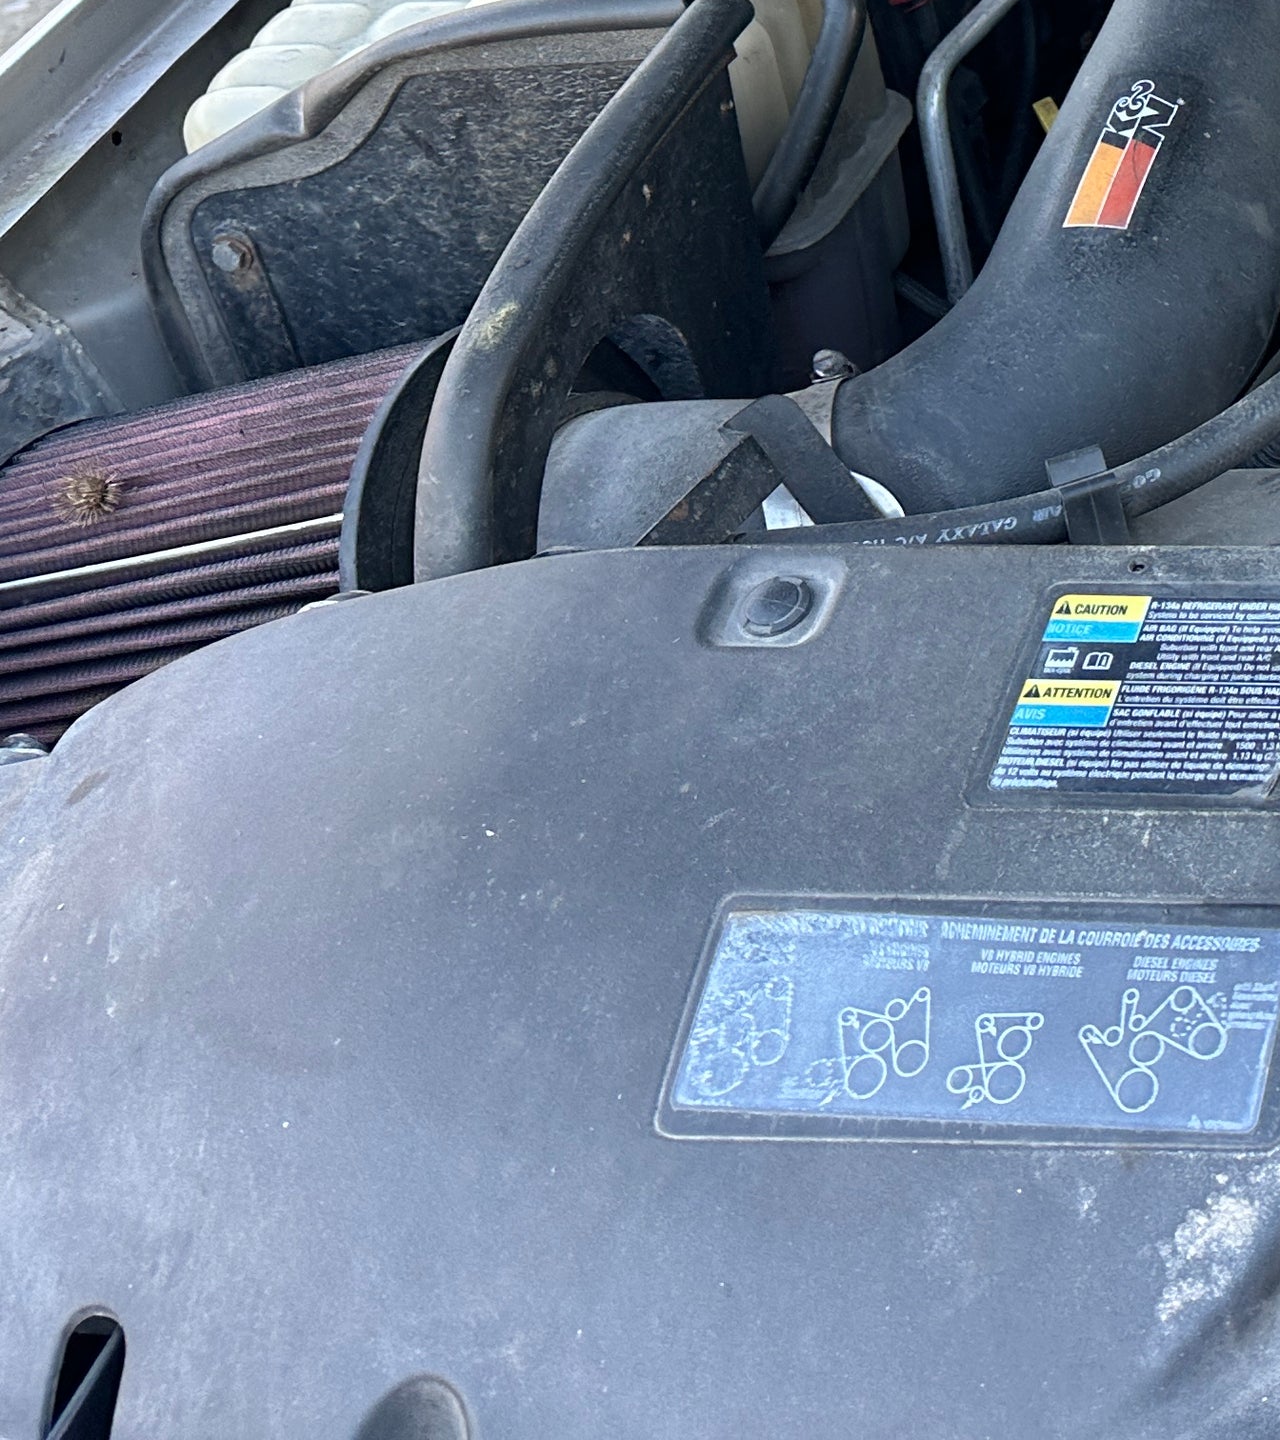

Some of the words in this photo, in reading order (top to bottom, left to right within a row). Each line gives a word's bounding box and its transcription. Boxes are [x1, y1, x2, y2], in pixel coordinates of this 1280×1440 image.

[937, 516, 1018, 542] GALAXY
[1073, 604, 1128, 615] CAUTION
[1046, 623, 1091, 634] NOTICE
[1042, 687, 1112, 698] ATTENTION
[1014, 708, 1046, 719] AVIS
[1038, 927, 1057, 944] DE
[1058, 929, 1076, 945] LA
[1145, 933, 1170, 949] DES
[995, 949, 1035, 963] HYBRID
[1036, 952, 1081, 965] ENGINES
[1132, 955, 1170, 970] DIESEL
[971, 961, 1021, 975] MOTEURS
[1037, 965, 1084, 978] HYBRIDE
[1127, 968, 1178, 982] MOTEURS
[1179, 969, 1217, 984] DIESEL
